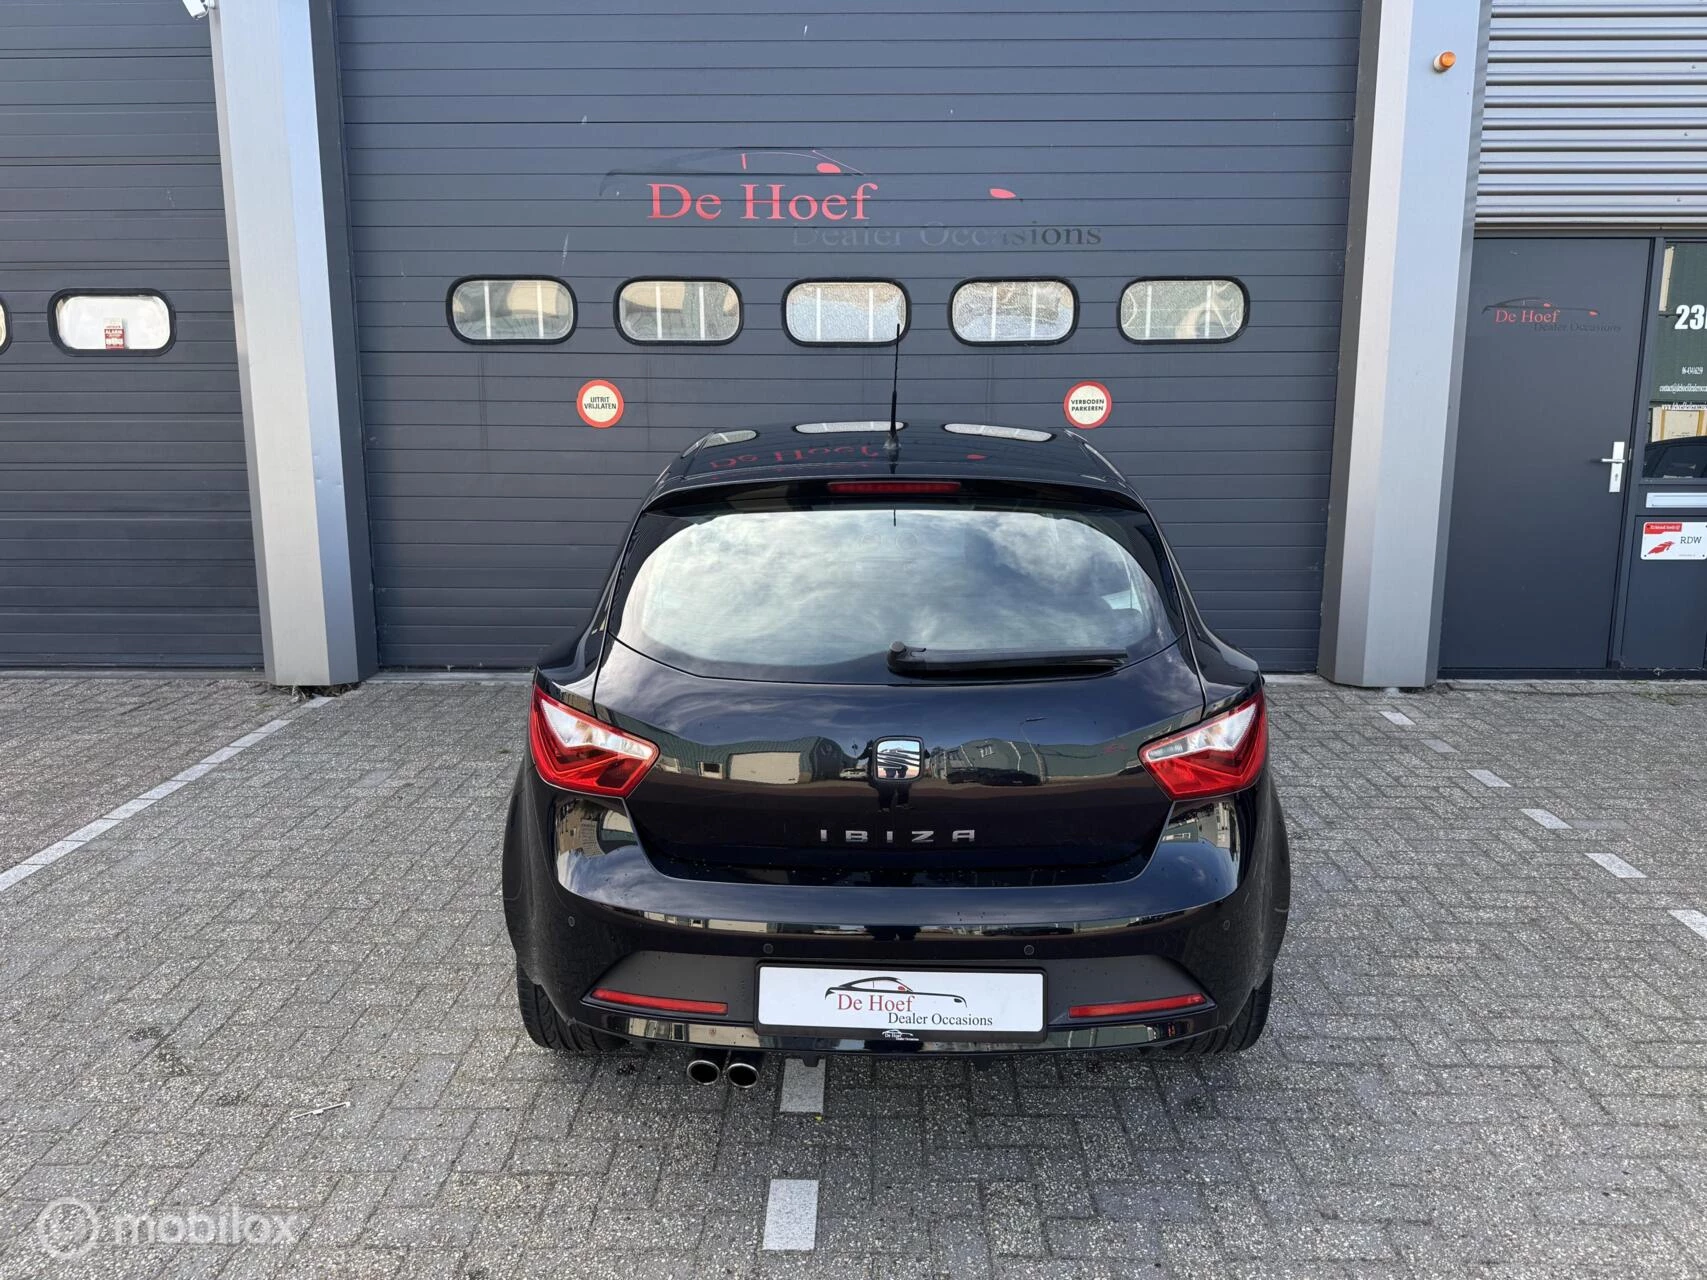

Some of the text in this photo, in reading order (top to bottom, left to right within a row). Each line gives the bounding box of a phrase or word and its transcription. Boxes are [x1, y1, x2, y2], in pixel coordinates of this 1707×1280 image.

[646, 182, 879, 221] De Hoef
[791, 221, 902, 247] Dealer
[1495, 308, 1561, 323] De Hoef
[1674, 304, 1707, 330] 23
[1680, 536, 1703, 545] RDW
[820, 829, 976, 843] IBIZA
[837, 994, 915, 1012] De Hoef
[888, 1012, 993, 1026] Dealer Occasions
